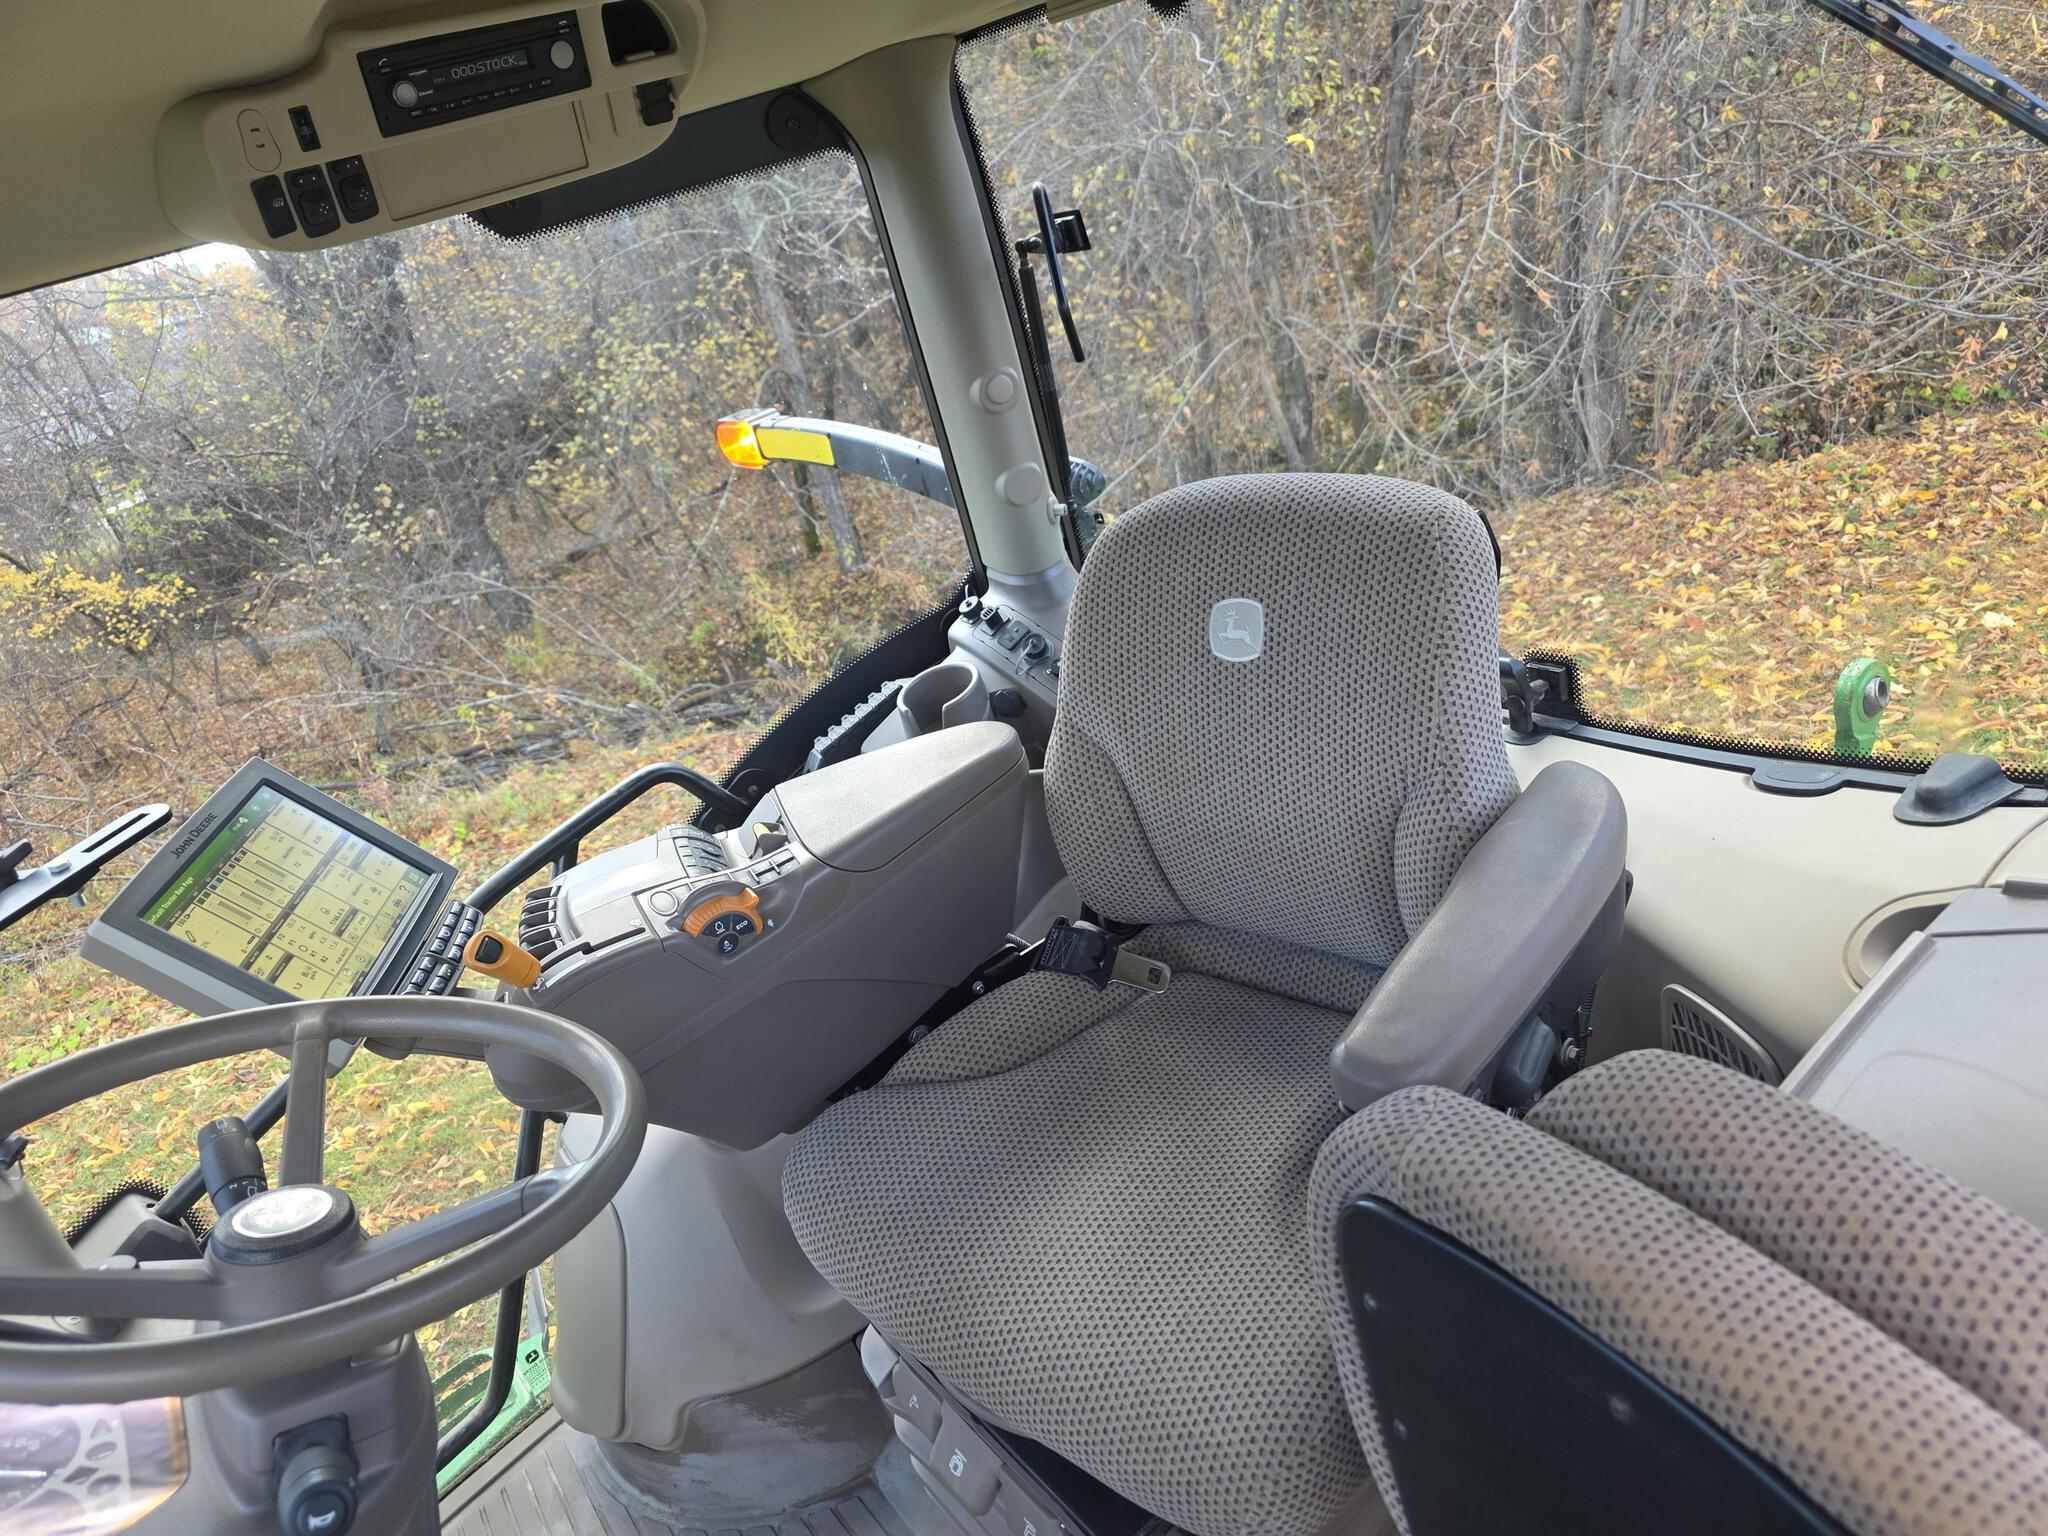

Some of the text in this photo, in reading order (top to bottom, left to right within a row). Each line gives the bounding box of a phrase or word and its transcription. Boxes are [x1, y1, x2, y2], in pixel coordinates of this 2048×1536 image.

[451, 55, 517, 79] OODSTOCK
[171, 812, 217, 859] JOHN DEERE
[160, 892, 178, 909] Tractor
[736, 921, 747, 930] ECO
